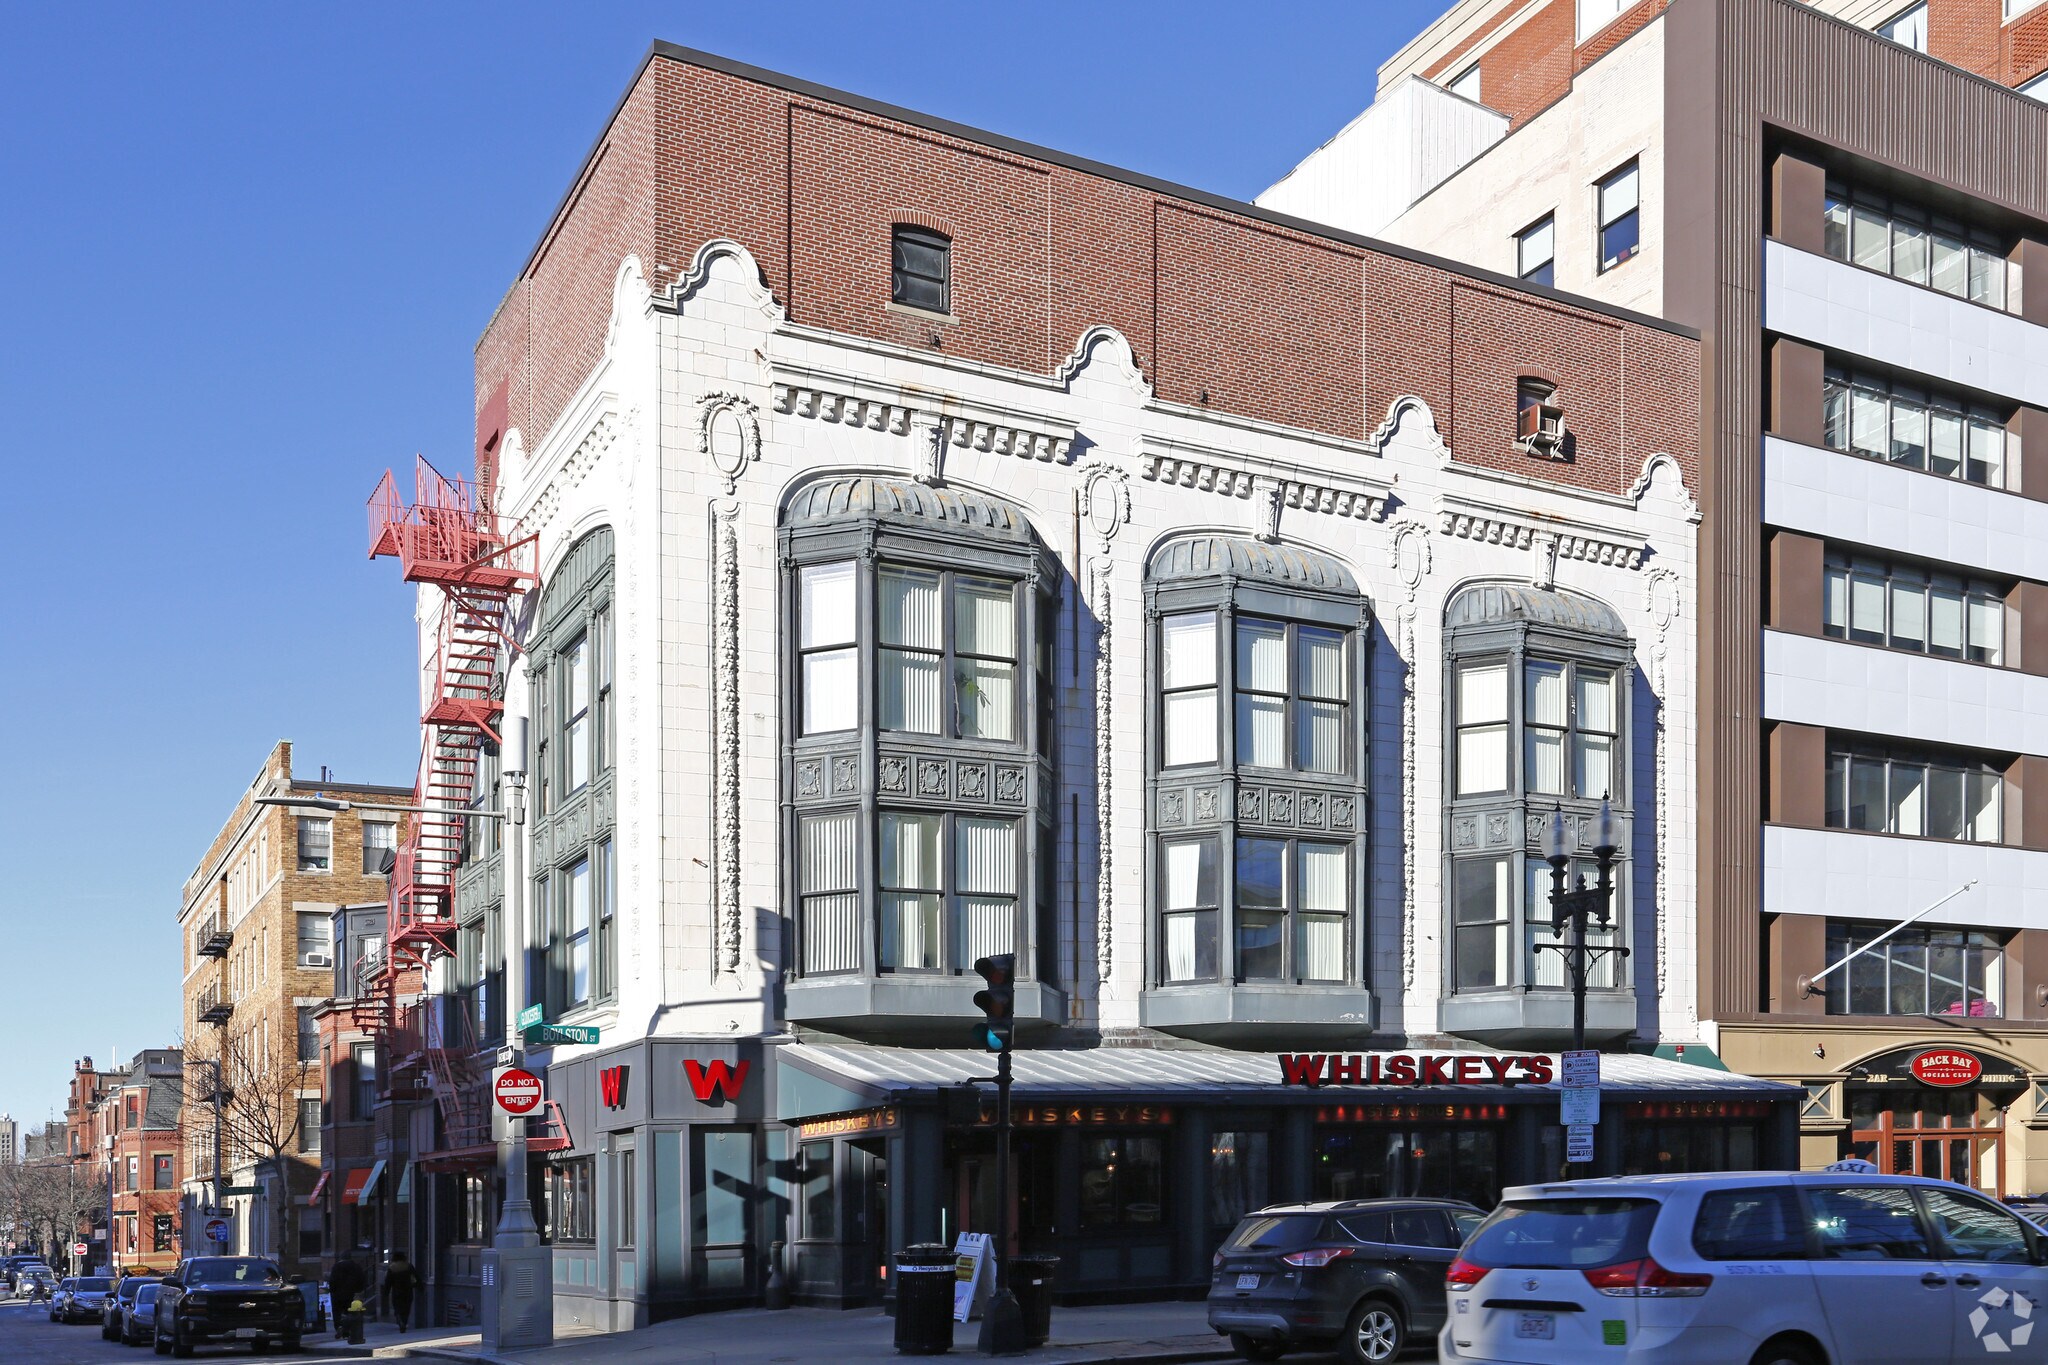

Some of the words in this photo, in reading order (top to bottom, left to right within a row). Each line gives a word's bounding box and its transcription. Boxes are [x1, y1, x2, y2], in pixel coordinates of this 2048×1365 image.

[543, 1027, 588, 1042] BOYLSTON
[1921, 1055, 1950, 1068] BACK
[1952, 1055, 1973, 1068] BAY
[1279, 1055, 1553, 1085] WHISKEY'S
[501, 1079, 514, 1087] DO
[517, 1078, 535, 1086] NOT
[683, 1060, 750, 1101] W
[1866, 1073, 1889, 1083] BAR
[1981, 1074, 2016, 1083] DINING
[600, 1065, 624, 1107] W
[505, 1096, 532, 1104] ENTER
[804, 1110, 896, 1135] WHISKEY'S
[1826, 1163, 1868, 1173] TAXI
